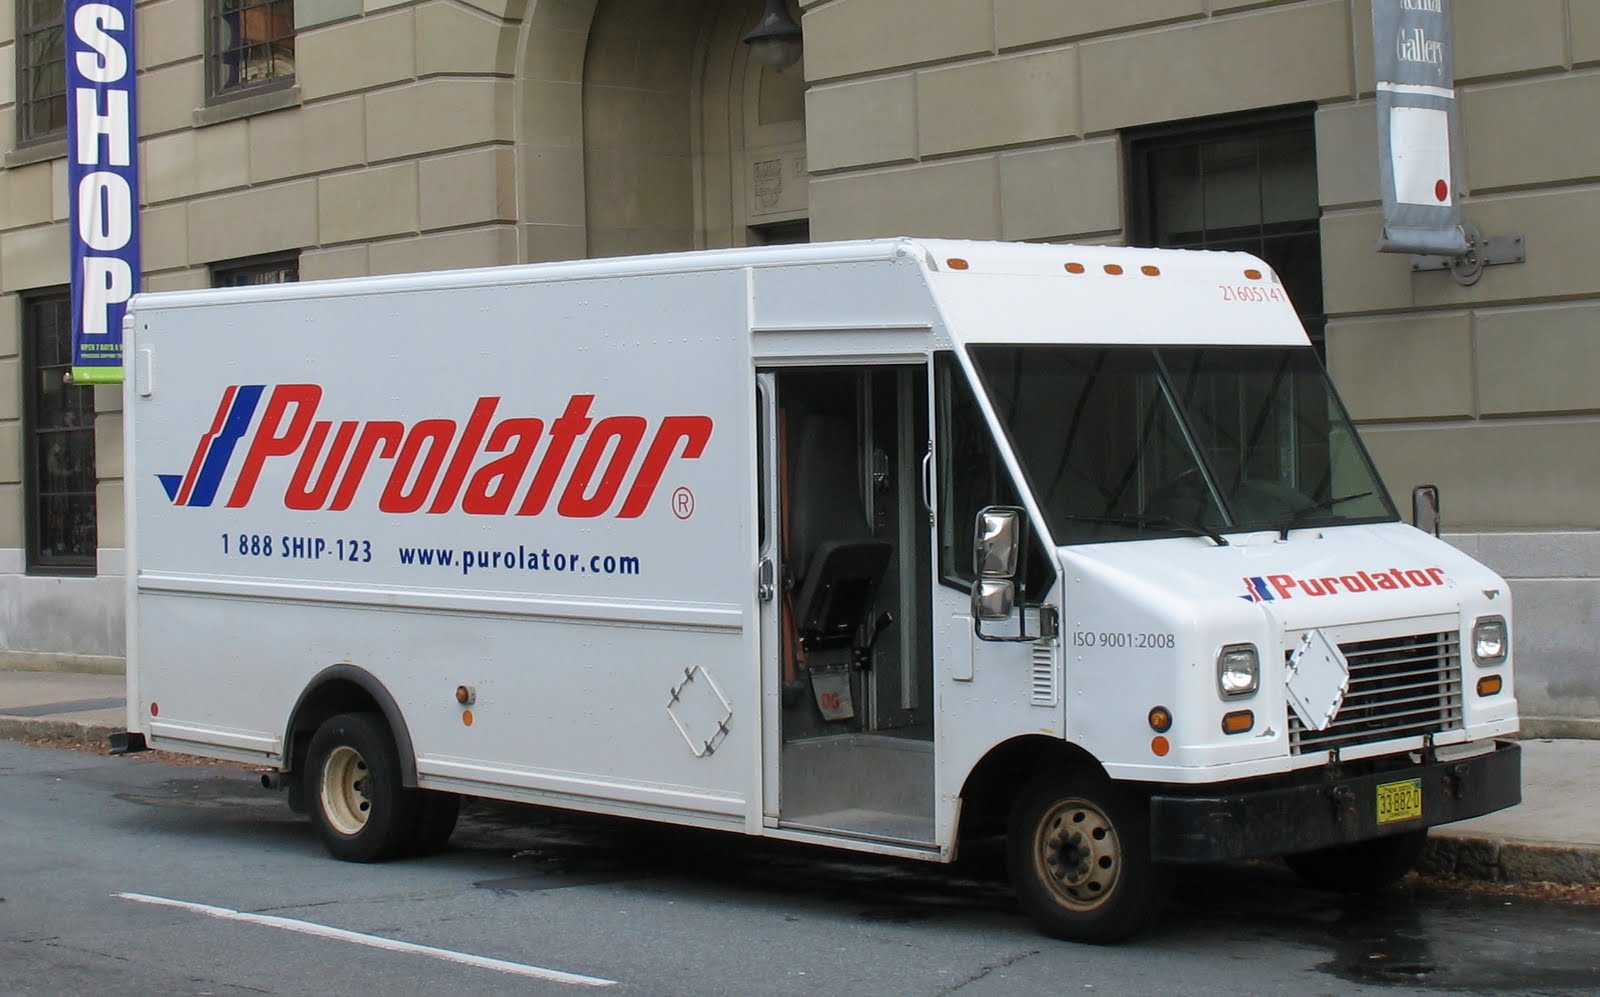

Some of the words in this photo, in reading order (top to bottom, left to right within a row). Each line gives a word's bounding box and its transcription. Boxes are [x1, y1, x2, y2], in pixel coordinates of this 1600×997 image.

[1396, 27, 1444, 76] Gallery
[74, 4, 132, 334] SHOP
[1219, 285, 1286, 302] 21605141
[226, 383, 714, 519] Purolator
[221, 533, 229, 554] 1
[238, 534, 273, 557] 888
[281, 536, 372, 563] SHIP-123
[398, 545, 640, 575] www.purolator.com
[1267, 567, 1445, 600] Purolator
[1073, 631, 1096, 647] ISO
[1099, 632, 1175, 648] 9001:2008
